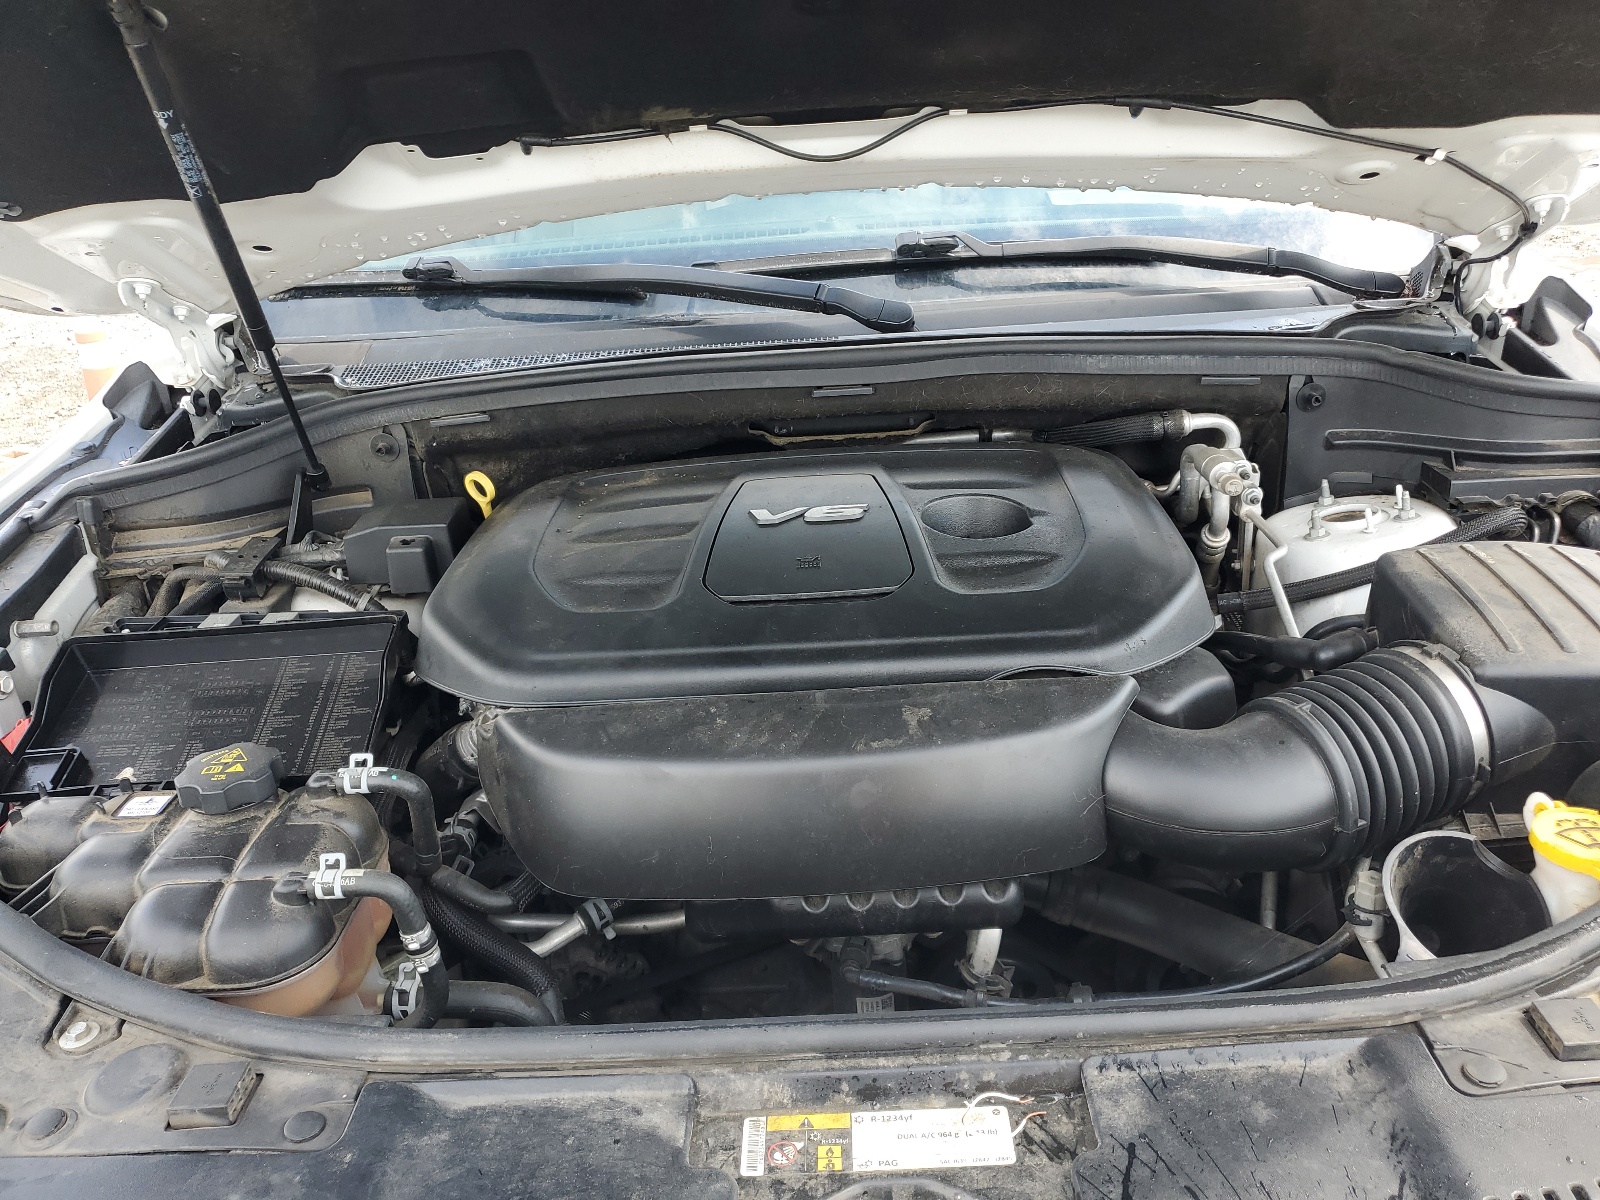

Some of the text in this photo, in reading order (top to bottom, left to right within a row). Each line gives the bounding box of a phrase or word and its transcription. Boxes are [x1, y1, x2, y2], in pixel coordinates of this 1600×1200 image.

[747, 502, 870, 526] V6
[870, 1113, 913, 1123] R-1234yf
[878, 1159, 899, 1168] PAG
